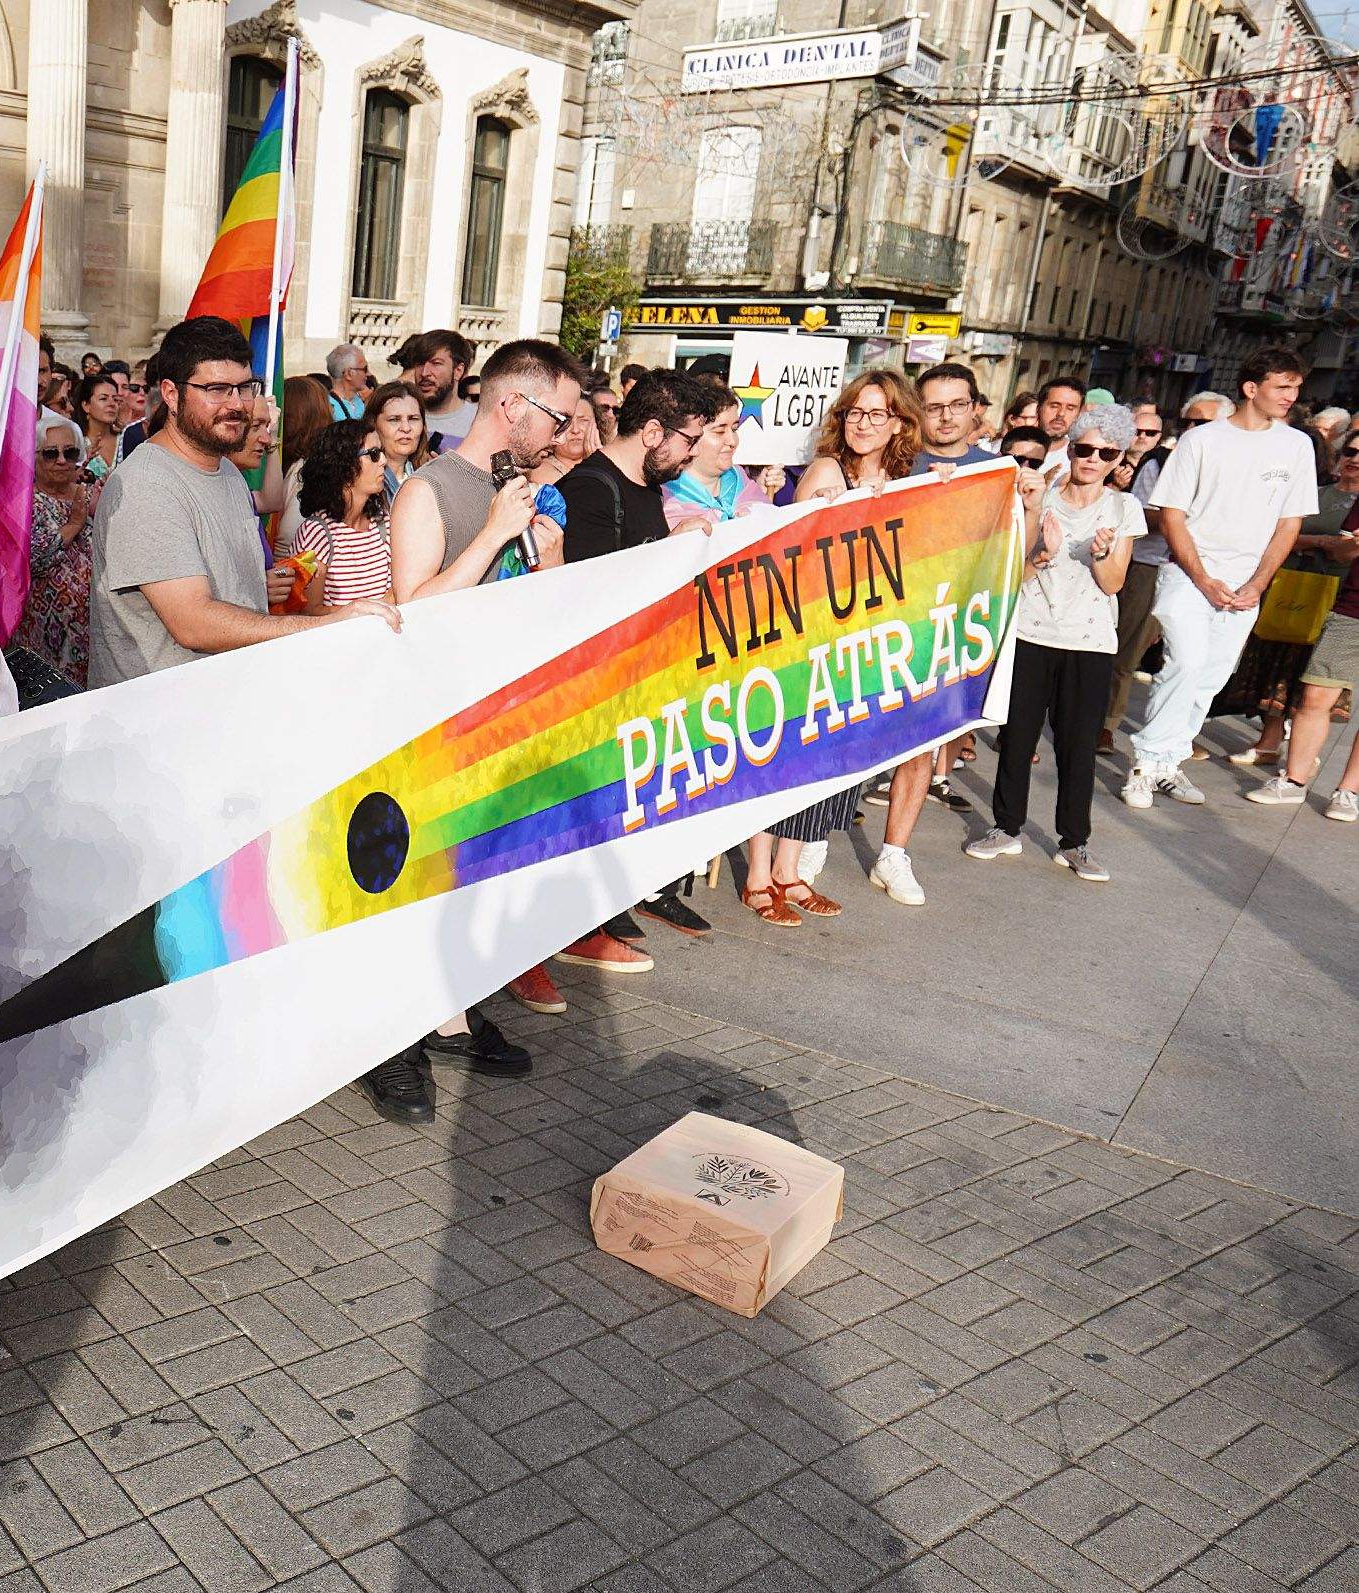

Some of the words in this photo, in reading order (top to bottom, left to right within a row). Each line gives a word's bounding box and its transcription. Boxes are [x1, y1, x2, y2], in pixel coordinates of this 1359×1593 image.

[689, 53, 769, 74] CLINICA
[784, 40, 872, 64] DENTAL
[729, 316, 791, 325] INMOBILIARIA
[739, 305, 781, 316] GESTION
[609, 314, 618, 337] P
[778, 365, 839, 388] AVANTE
[774, 394, 827, 427] LGBT
[694, 545, 805, 670] NIN
[816, 517, 906, 622] UN
[616, 664, 786, 832] PASO
[799, 582, 995, 746] ATRÁS
